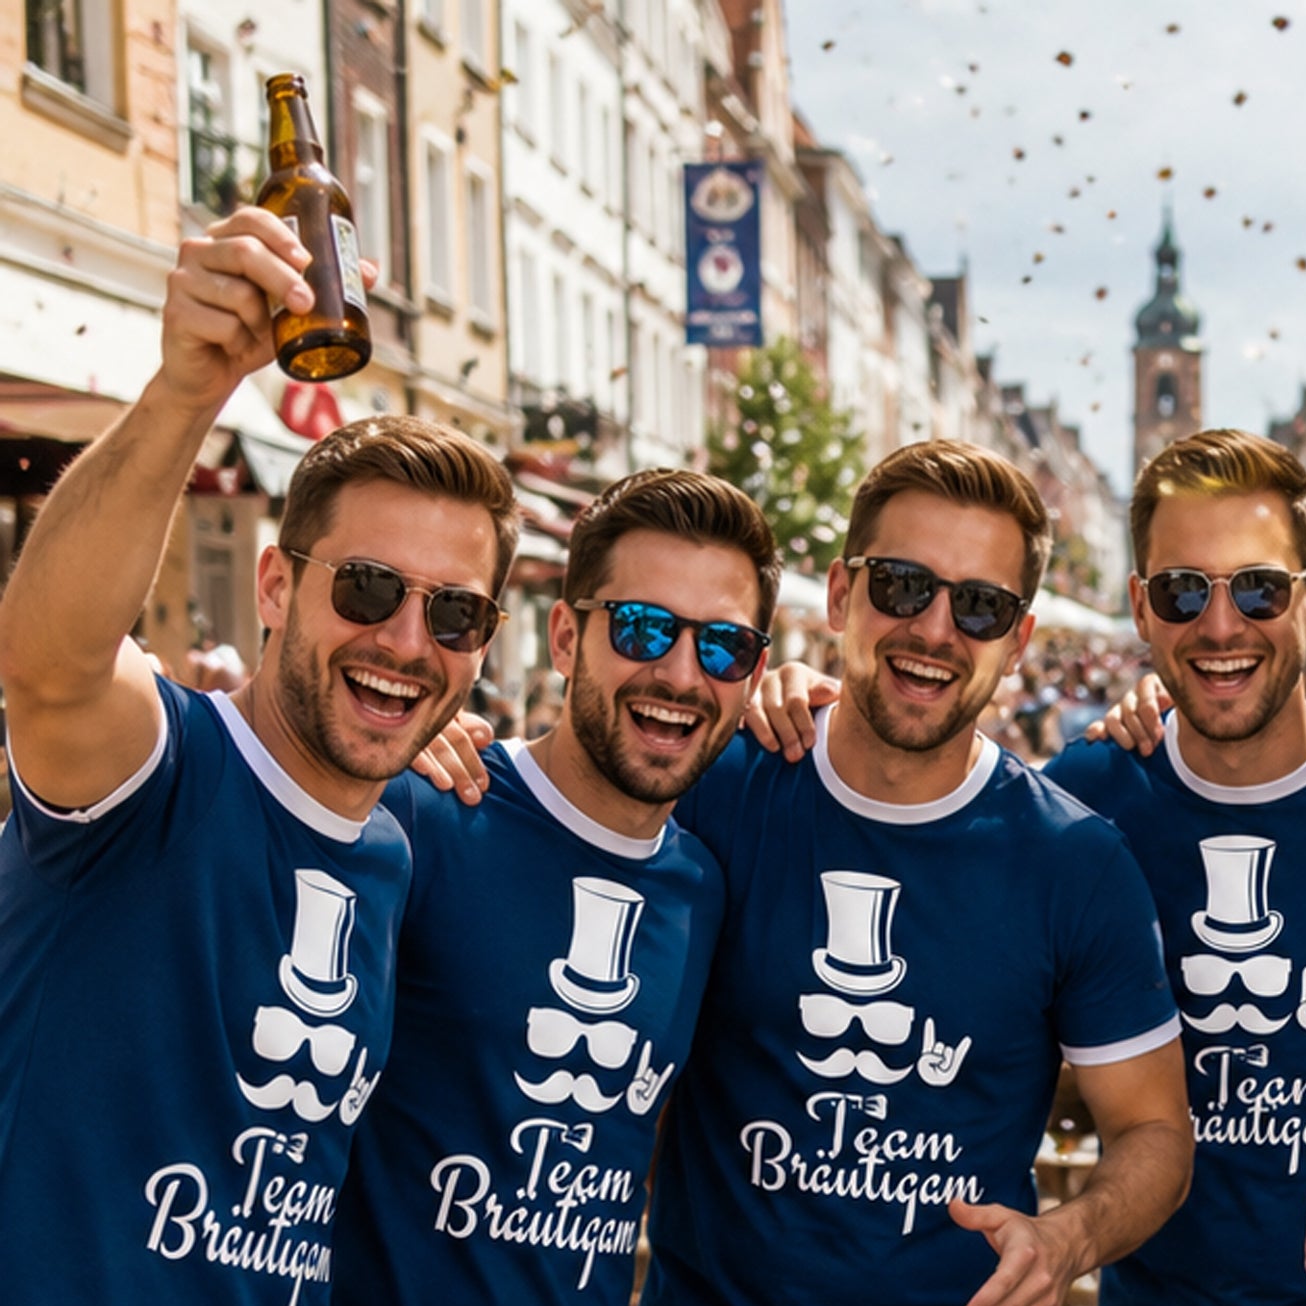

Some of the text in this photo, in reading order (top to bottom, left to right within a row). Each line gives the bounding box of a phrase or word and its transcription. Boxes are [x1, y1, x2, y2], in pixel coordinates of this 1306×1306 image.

[509, 1117, 634, 1204] Team
[805, 1091, 964, 1163] Team
[231, 1126, 336, 1225] Team
[739, 1119, 985, 1236] Bräutigam
